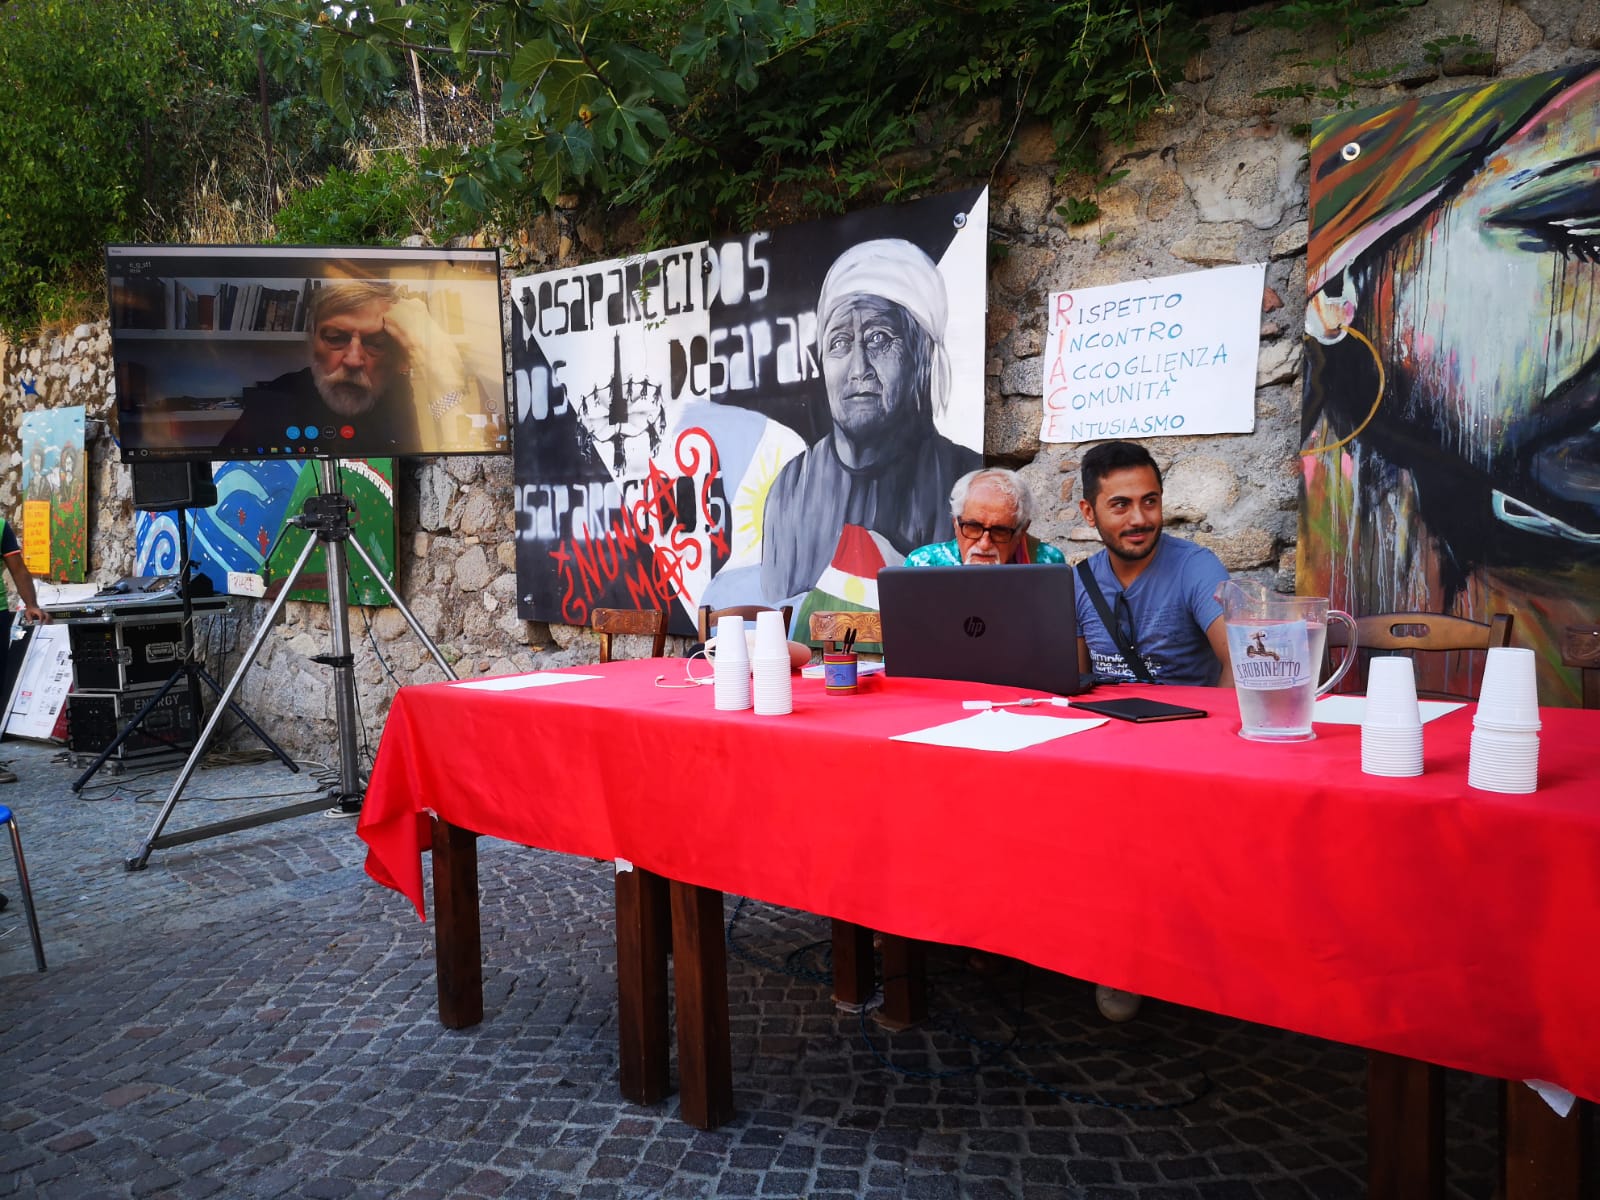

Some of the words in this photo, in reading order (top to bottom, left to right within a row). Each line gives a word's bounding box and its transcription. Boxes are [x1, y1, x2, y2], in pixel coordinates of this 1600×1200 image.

[1055, 293, 1183, 327] RISPETTO
[1058, 321, 1184, 353] INCONTRO
[1049, 343, 1228, 385] ACCOGLIENZA
[515, 360, 569, 424] DOS
[1047, 413, 1186, 440] ENTUSIASMO
[134, 694, 180, 710] ENRGY
